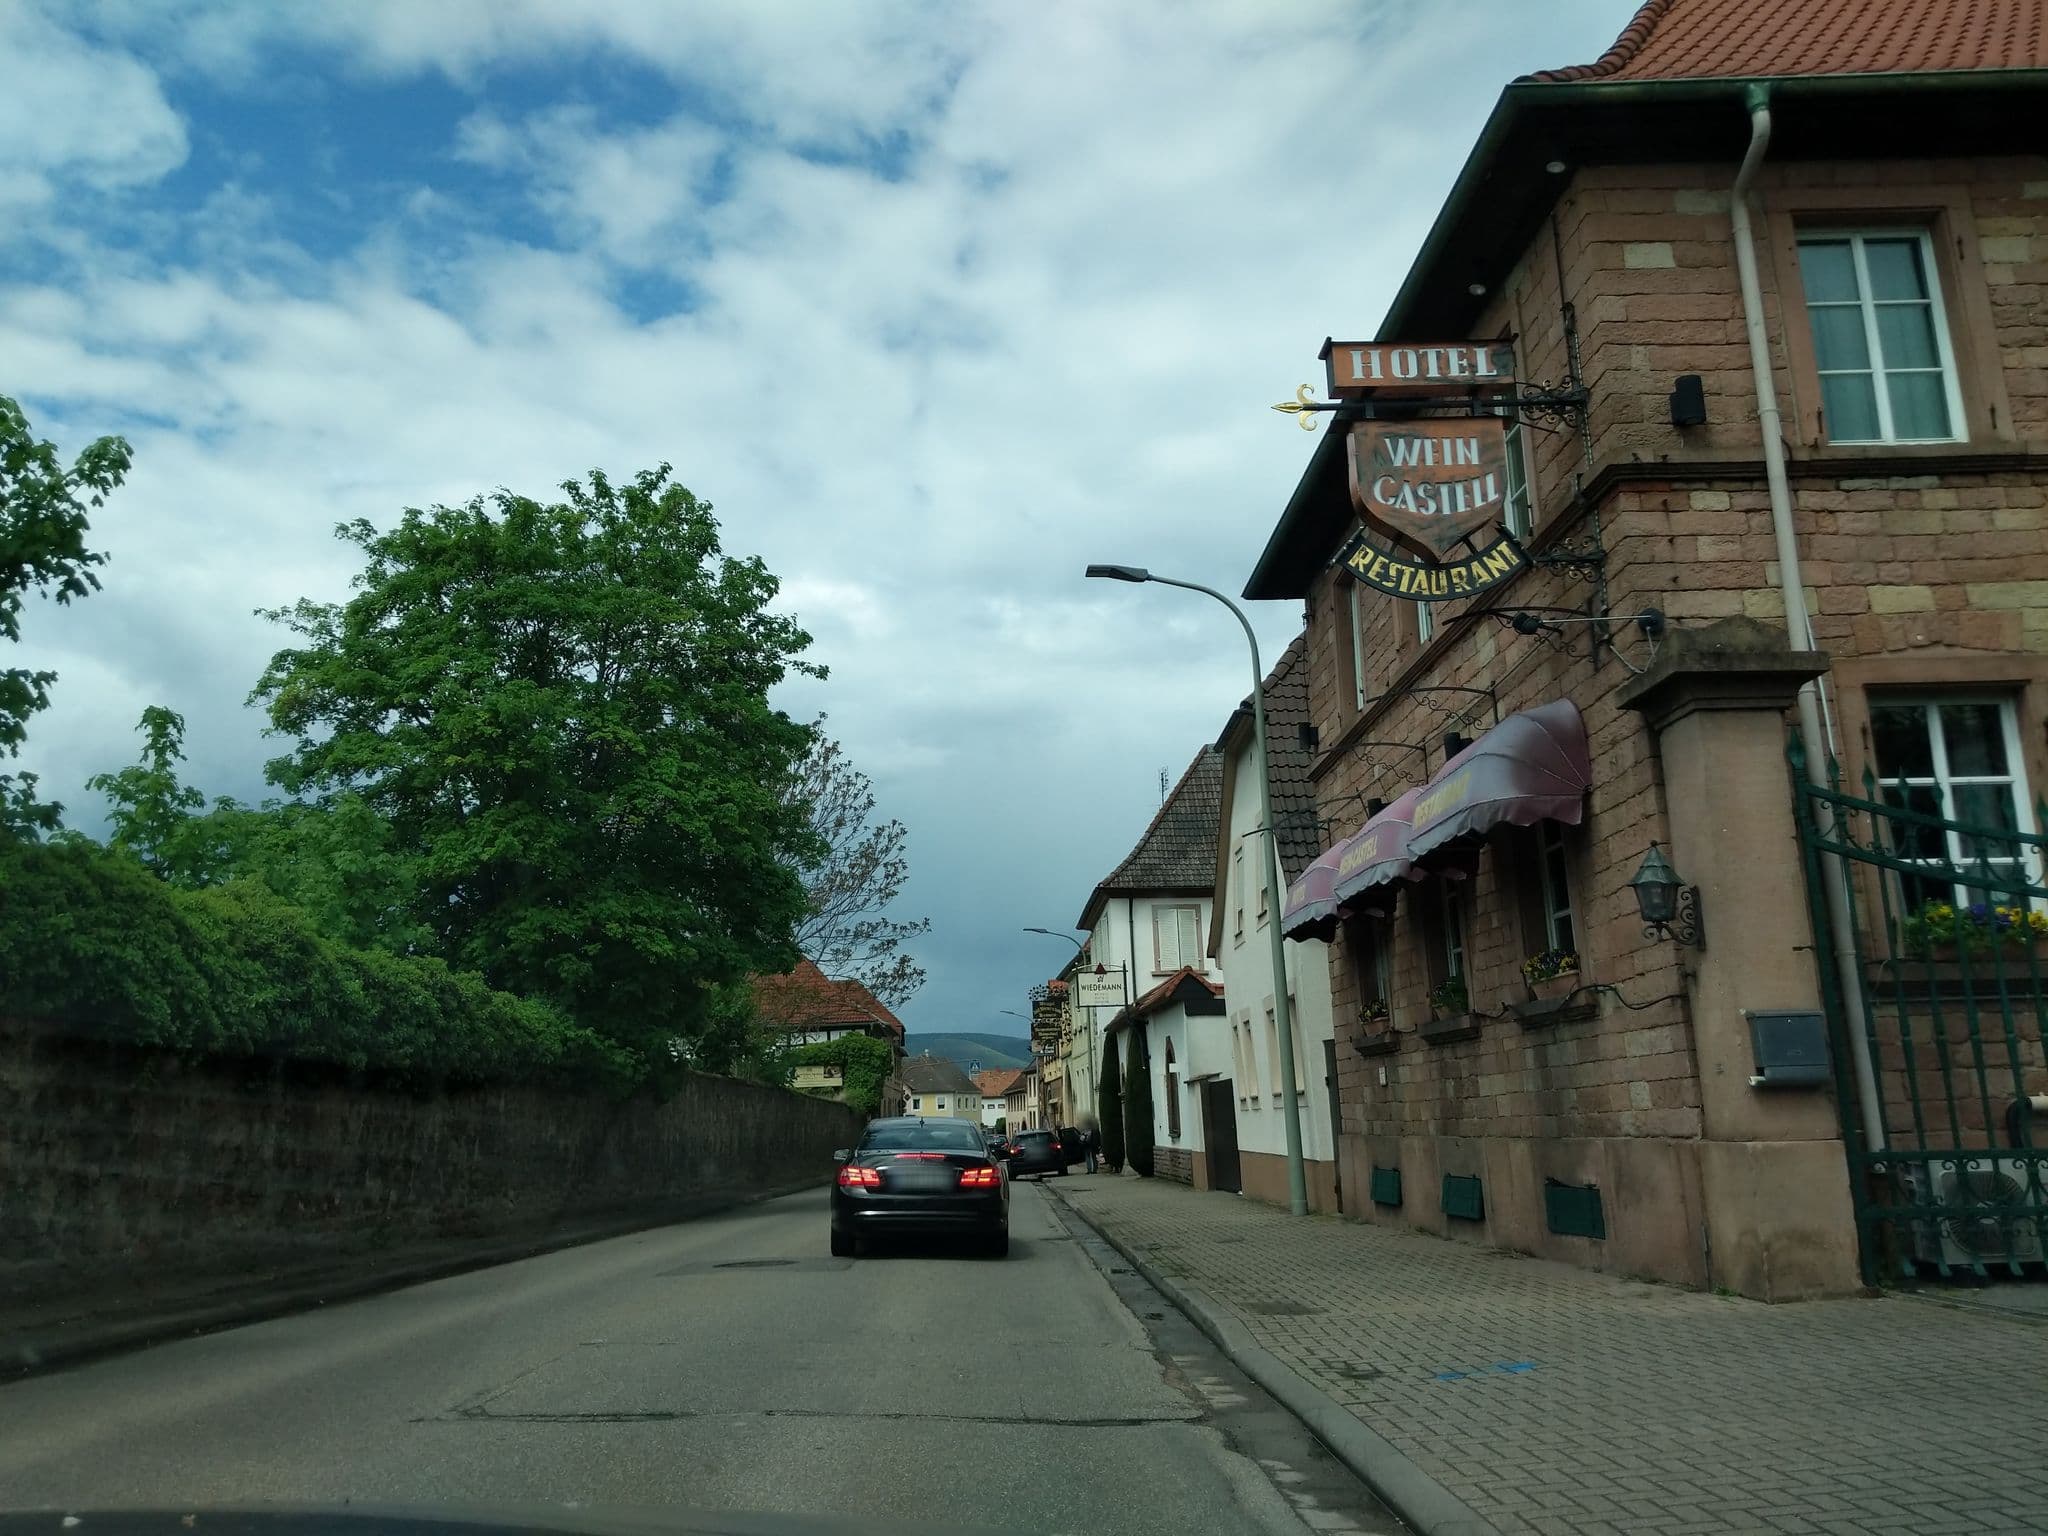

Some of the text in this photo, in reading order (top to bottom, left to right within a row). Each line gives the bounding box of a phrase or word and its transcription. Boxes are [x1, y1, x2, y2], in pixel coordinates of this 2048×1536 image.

[1350, 347, 1497, 379] HOTEL
[1384, 437, 1480, 467] WEIN
[1373, 473, 1499, 515] CASTELL
[1347, 541, 1520, 596] RESTAURANT
[1080, 983, 1122, 992] WIEDEMANN
